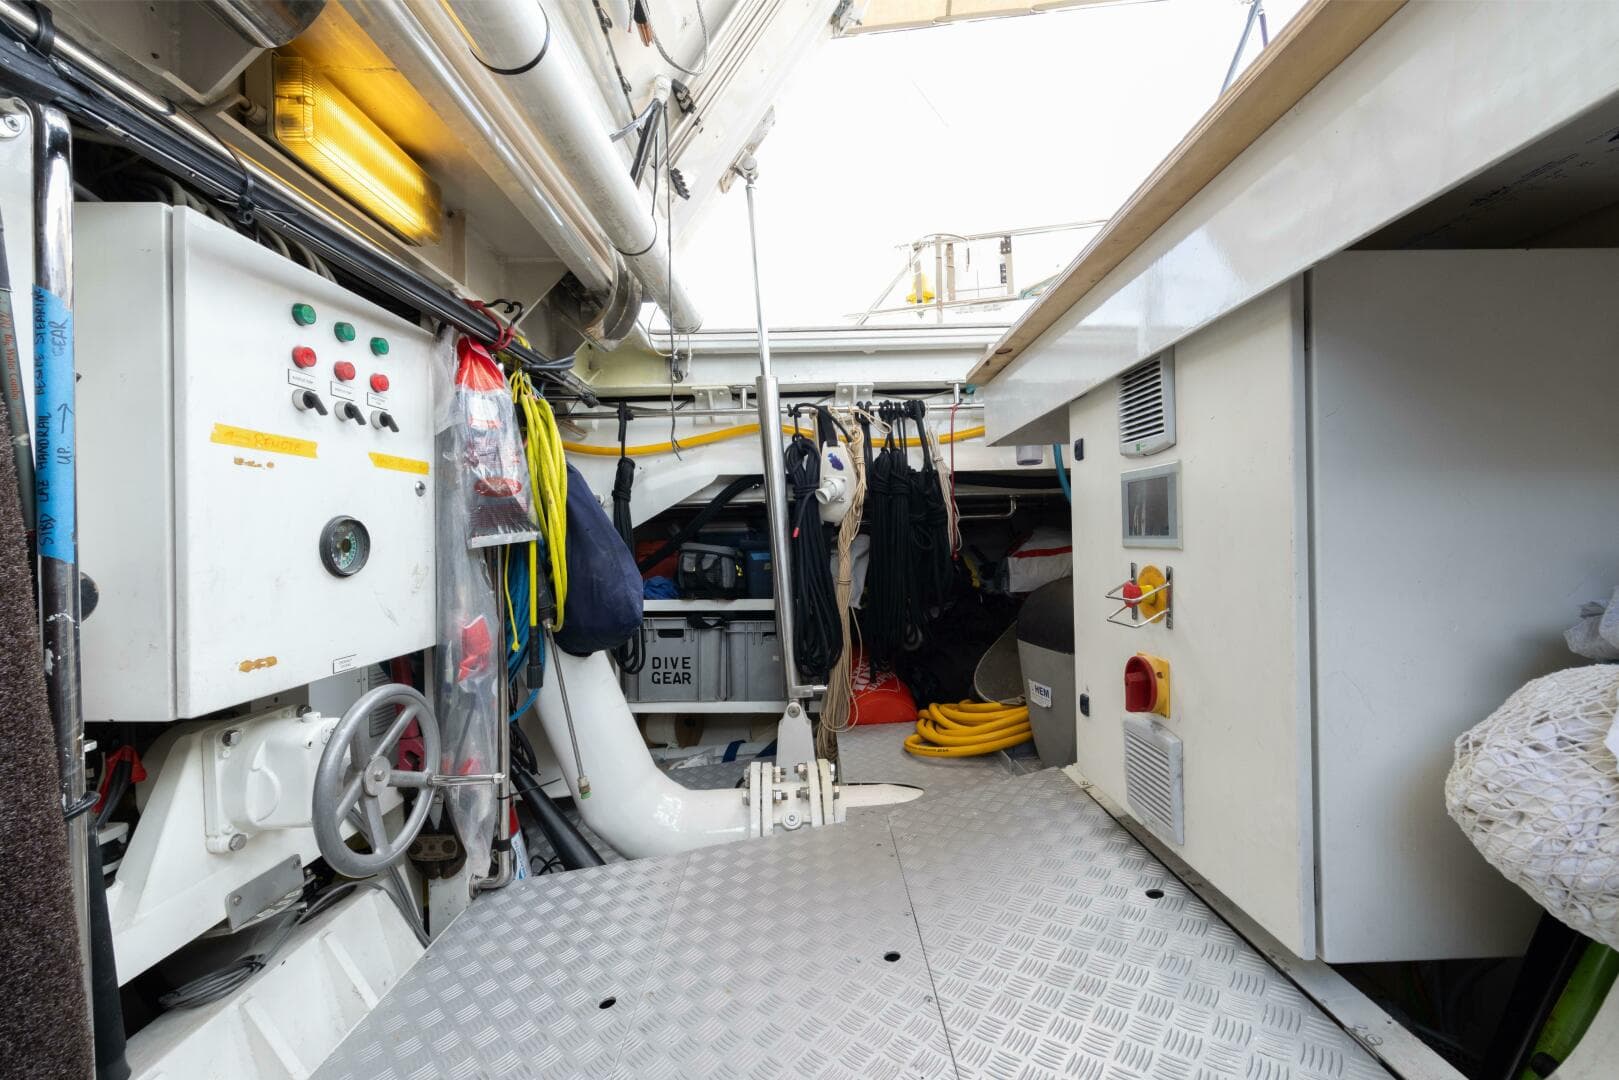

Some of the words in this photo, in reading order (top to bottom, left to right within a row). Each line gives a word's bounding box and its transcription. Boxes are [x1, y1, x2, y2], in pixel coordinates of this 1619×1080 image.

[48, 318, 68, 357] GEAR
[9, 372, 20, 401] Combo
[37, 411, 51, 469] HANDRAIL
[652, 656, 691, 669] DIVE
[651, 671, 692, 684] GEAR
